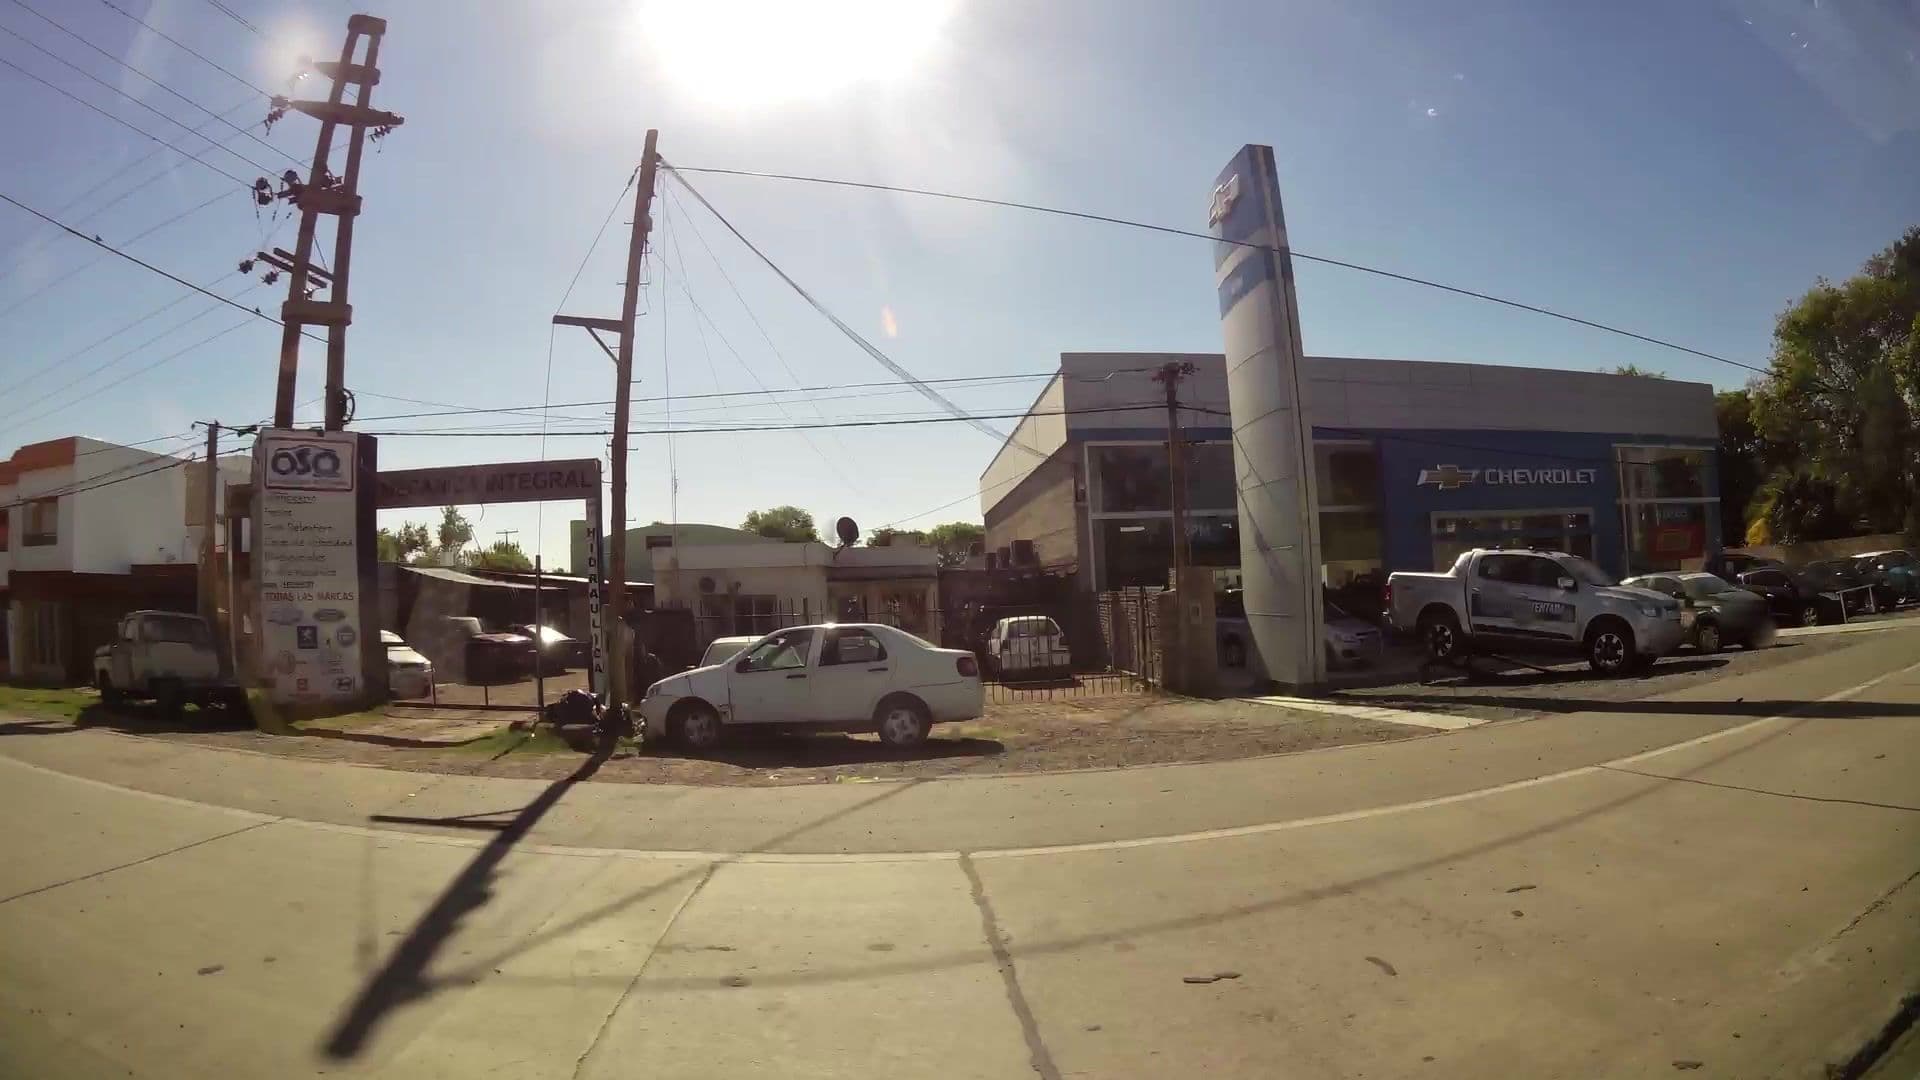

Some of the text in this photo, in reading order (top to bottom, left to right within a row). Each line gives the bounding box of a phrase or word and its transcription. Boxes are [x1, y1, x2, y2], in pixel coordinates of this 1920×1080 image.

[486, 470, 592, 492] INTEGRAL
[1485, 468, 1597, 486] CHEVROLET
[316, 591, 354, 601] MARCAS
